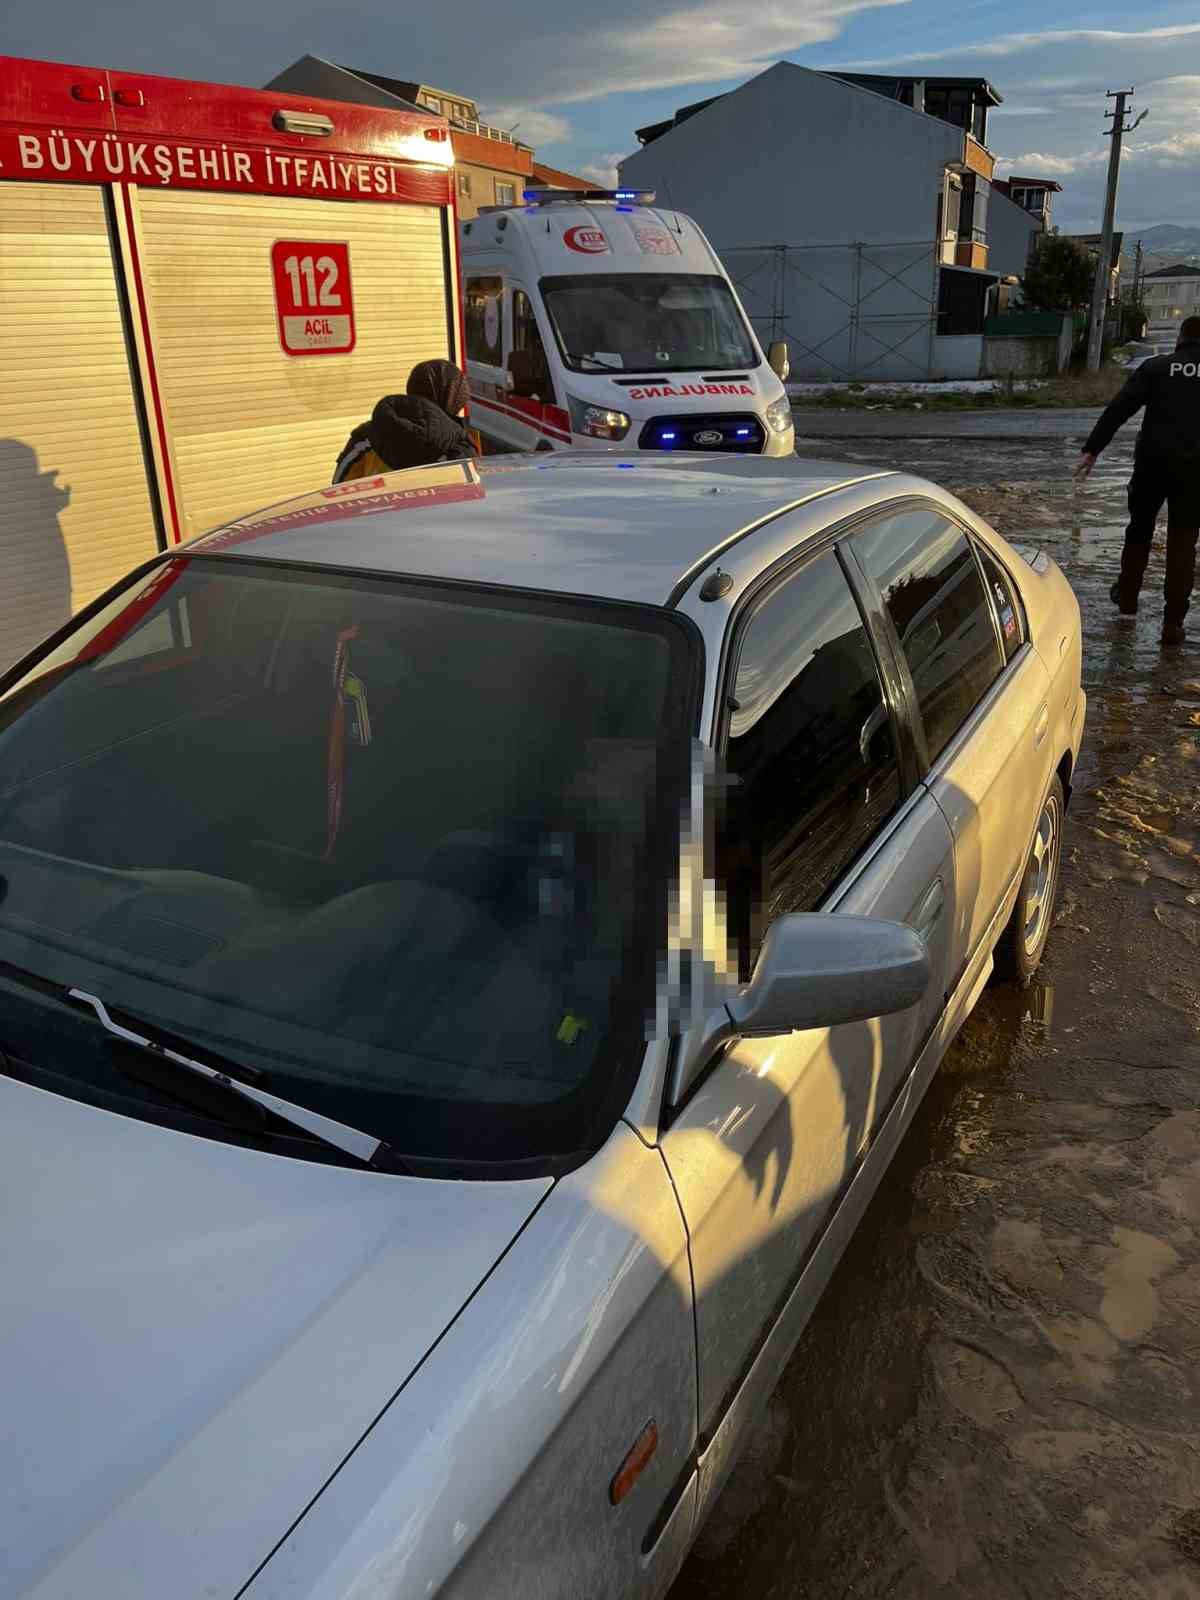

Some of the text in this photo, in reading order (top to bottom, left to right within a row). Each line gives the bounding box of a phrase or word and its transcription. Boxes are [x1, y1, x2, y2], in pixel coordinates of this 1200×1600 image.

[18, 128, 254, 184] BÜYÜKŞEHİR
[284, 255, 342, 307] 112
[304, 319, 333, 336] ACİL
